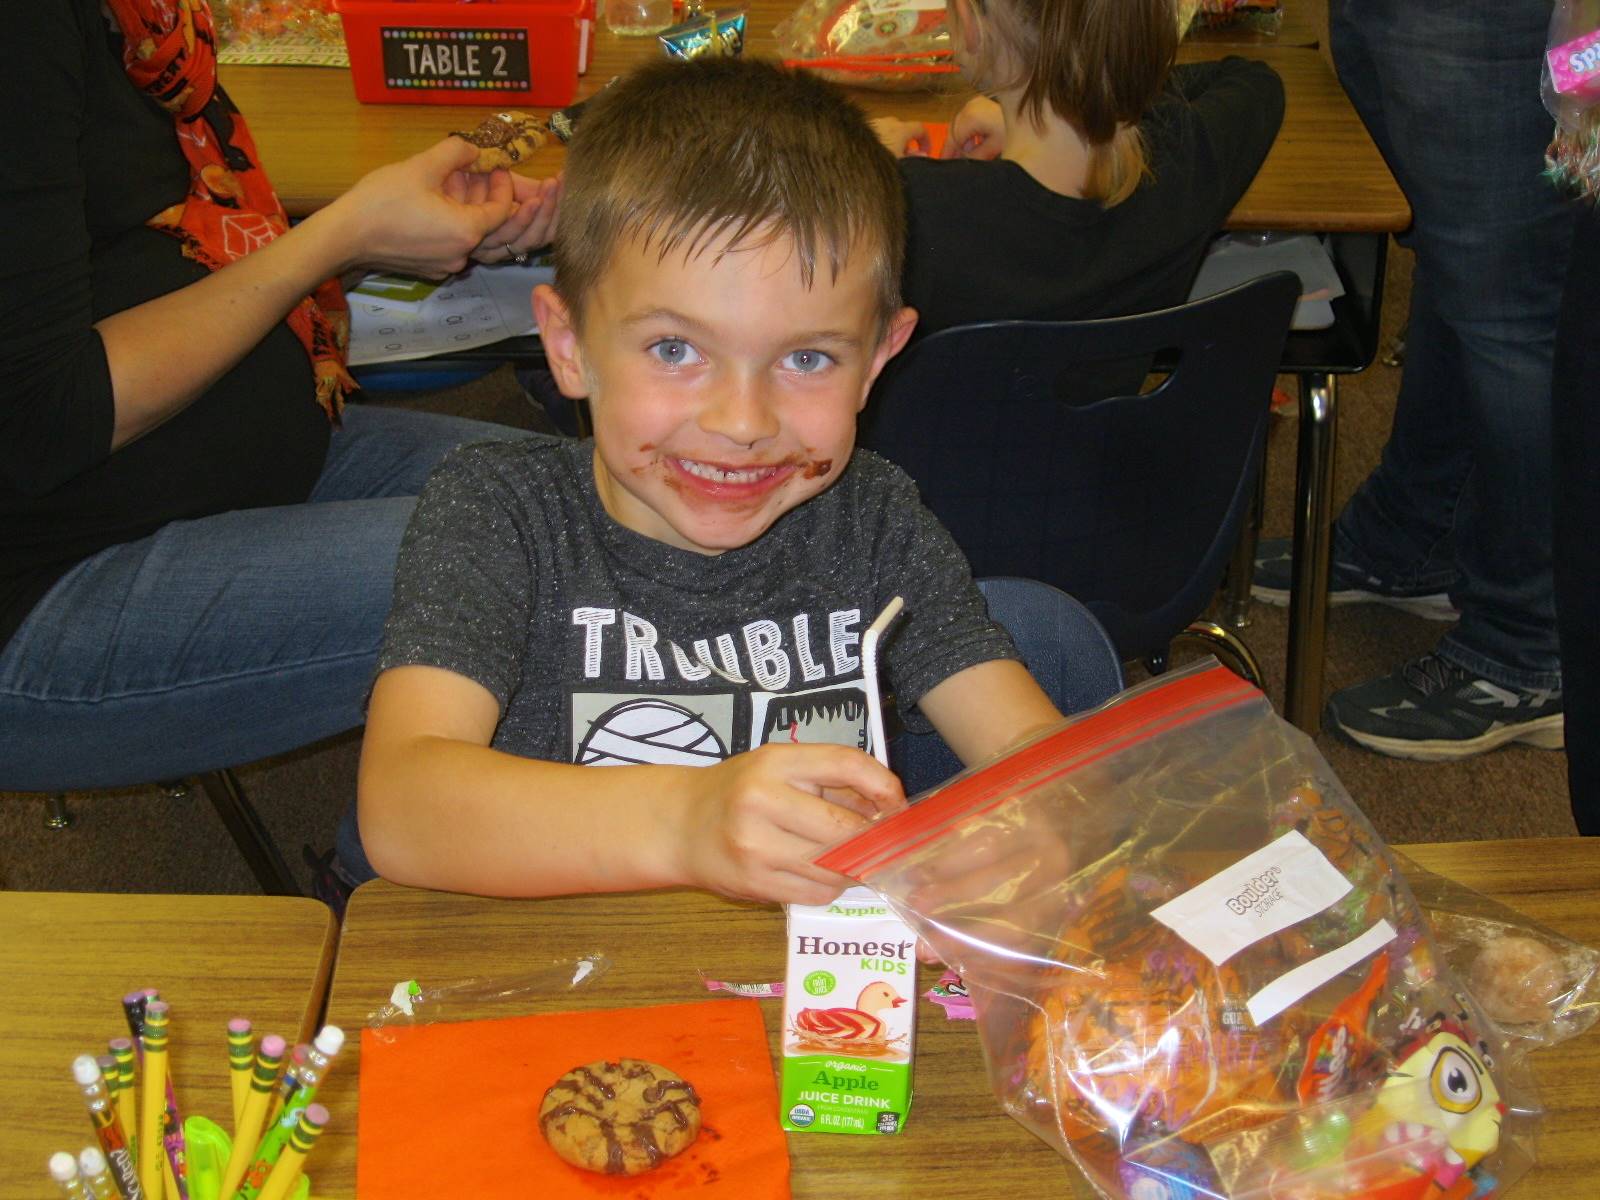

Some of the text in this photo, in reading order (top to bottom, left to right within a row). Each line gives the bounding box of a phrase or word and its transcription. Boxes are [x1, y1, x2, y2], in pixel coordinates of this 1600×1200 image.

[403, 43, 508, 76] TABLE 2
[572, 606, 862, 692] TROUBLE
[827, 905, 887, 917] Apple
[796, 935, 914, 960] Honest
[859, 957, 908, 976] KIDS
[825, 1059, 868, 1072] organic
[812, 1070, 879, 1091] Apple
[798, 1090, 840, 1105] JUICE
[843, 1093, 892, 1110] DRINK
